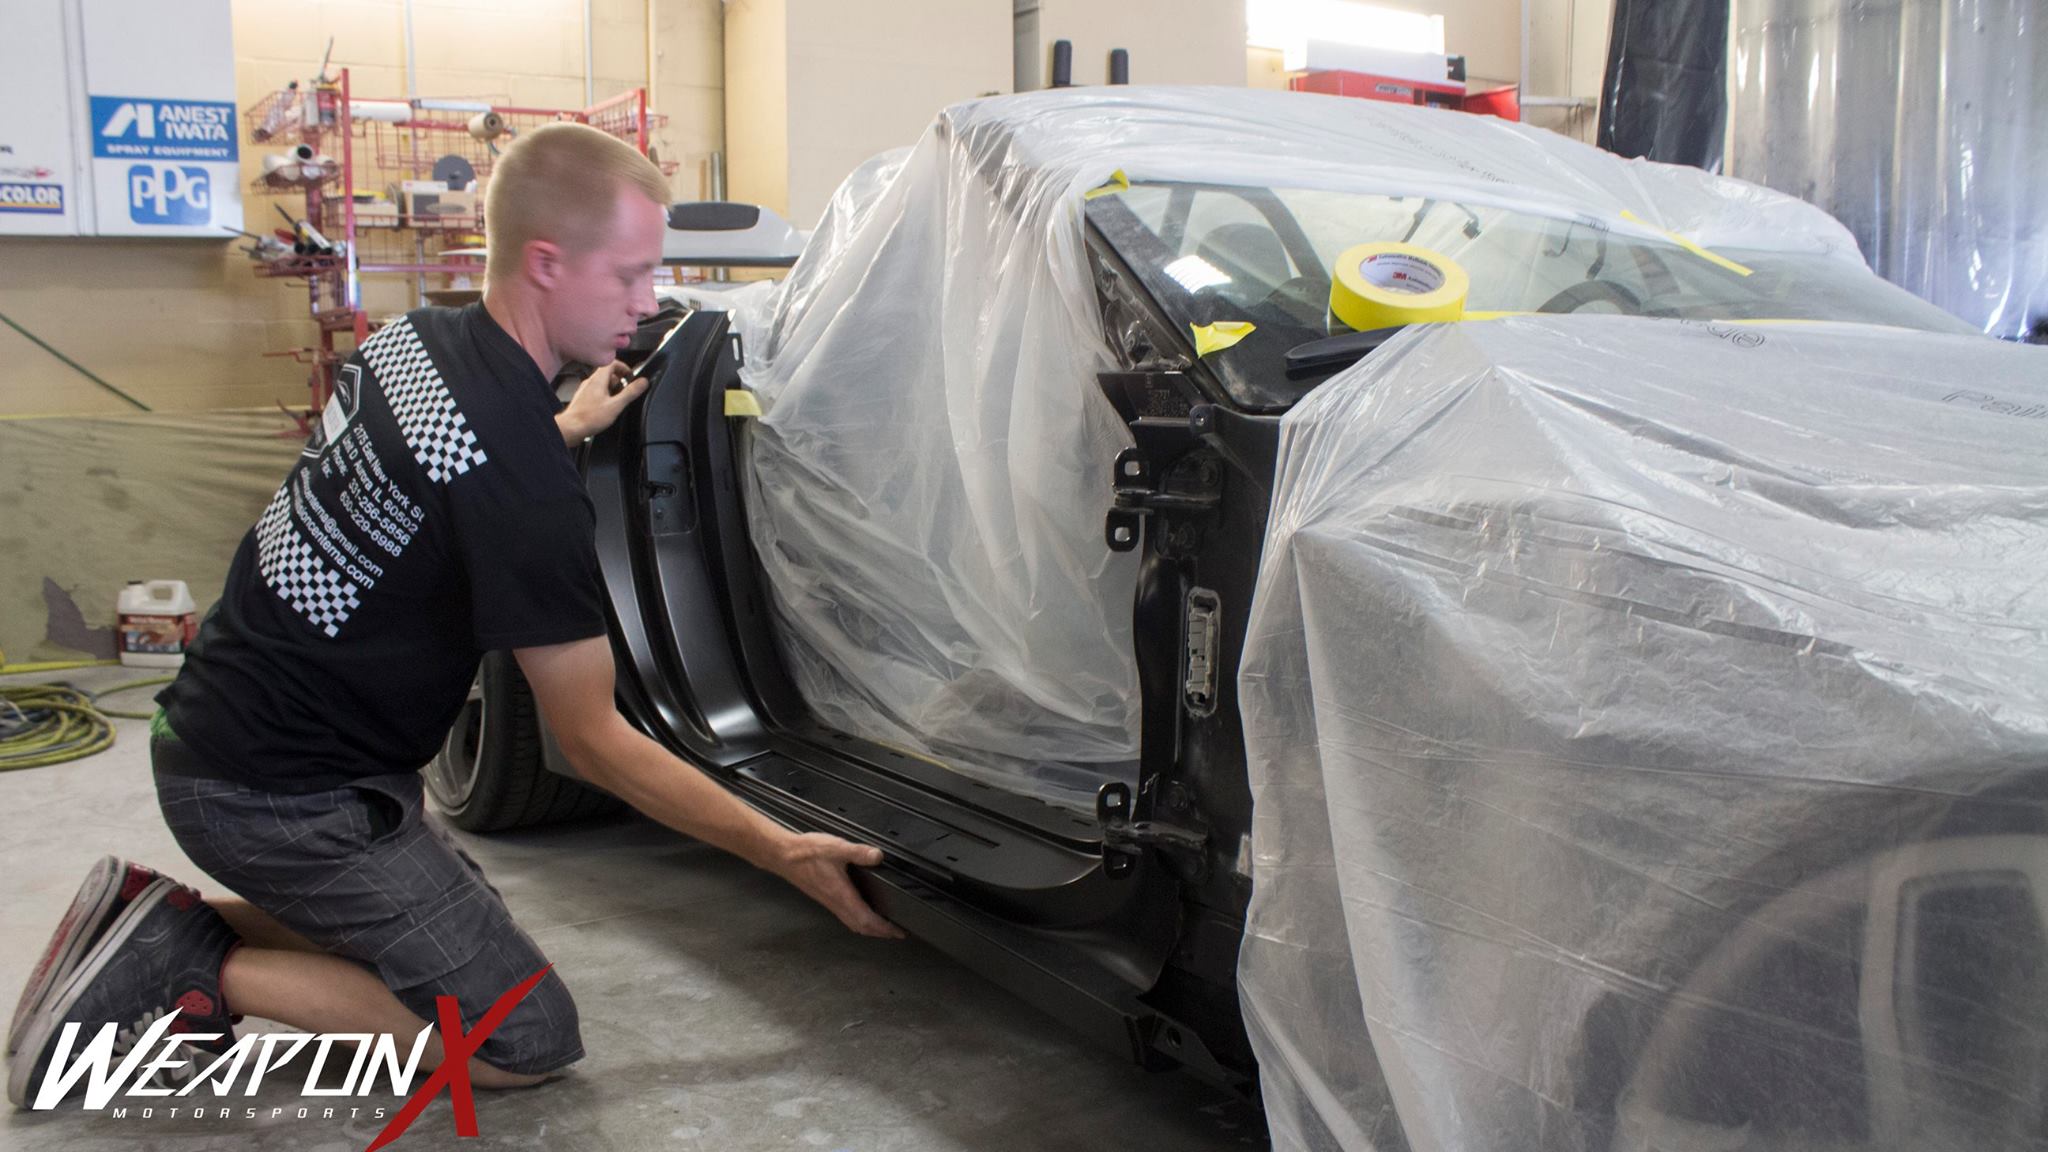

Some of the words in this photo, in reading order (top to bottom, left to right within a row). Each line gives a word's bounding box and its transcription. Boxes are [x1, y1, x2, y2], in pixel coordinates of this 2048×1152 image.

[158, 104, 231, 124] ANEST
[165, 122, 229, 141] IWATA
[106, 144, 150, 155] SPRAY
[153, 145, 229, 158] EQUIPMENT
[132, 161, 208, 216] PPG
[1392, 271, 1408, 280] 3M
[349, 448, 359, 460] D
[354, 459, 373, 491] Aurora
[372, 487, 382, 503] IL
[383, 499, 418, 535] 60502
[353, 423, 369, 446] 2175
[362, 440, 376, 464] East
[371, 458, 388, 483] New
[388, 480, 410, 509] York
[410, 505, 425, 522] St
[340, 490, 402, 557] 630-229-6988
[349, 478, 411, 546] 331-256-5856
